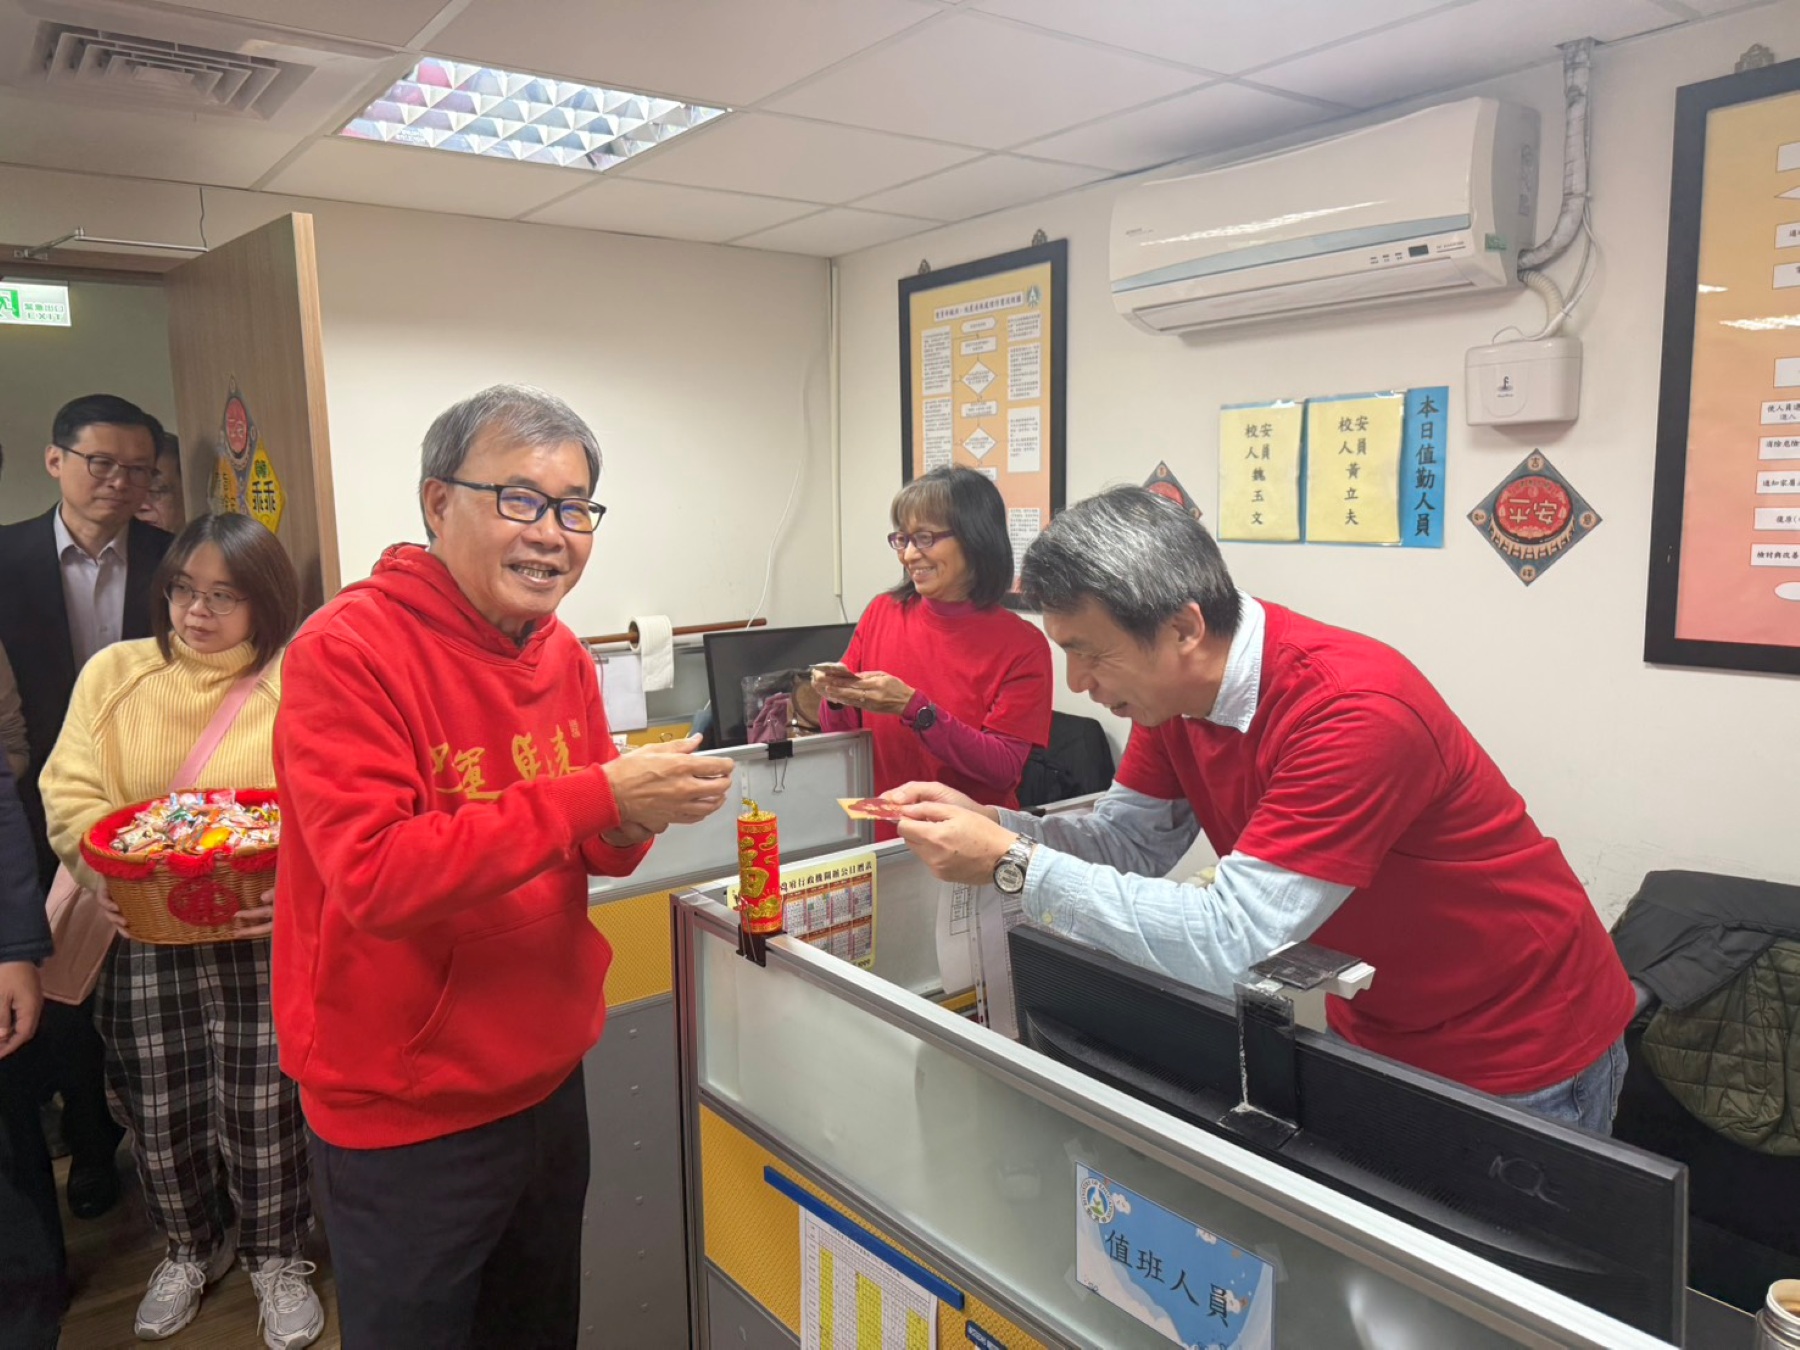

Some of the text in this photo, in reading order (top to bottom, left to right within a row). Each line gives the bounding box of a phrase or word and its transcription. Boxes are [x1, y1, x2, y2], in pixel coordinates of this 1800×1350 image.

[1344, 462, 1361, 526] 黃立夫
[1414, 395, 1439, 537] 本日值勤人員
[1509, 498, 1558, 525] 平安
[782, 861, 872, 892] 府行政機關辦公日曆表
[1104, 1229, 1229, 1328] 值班人員
